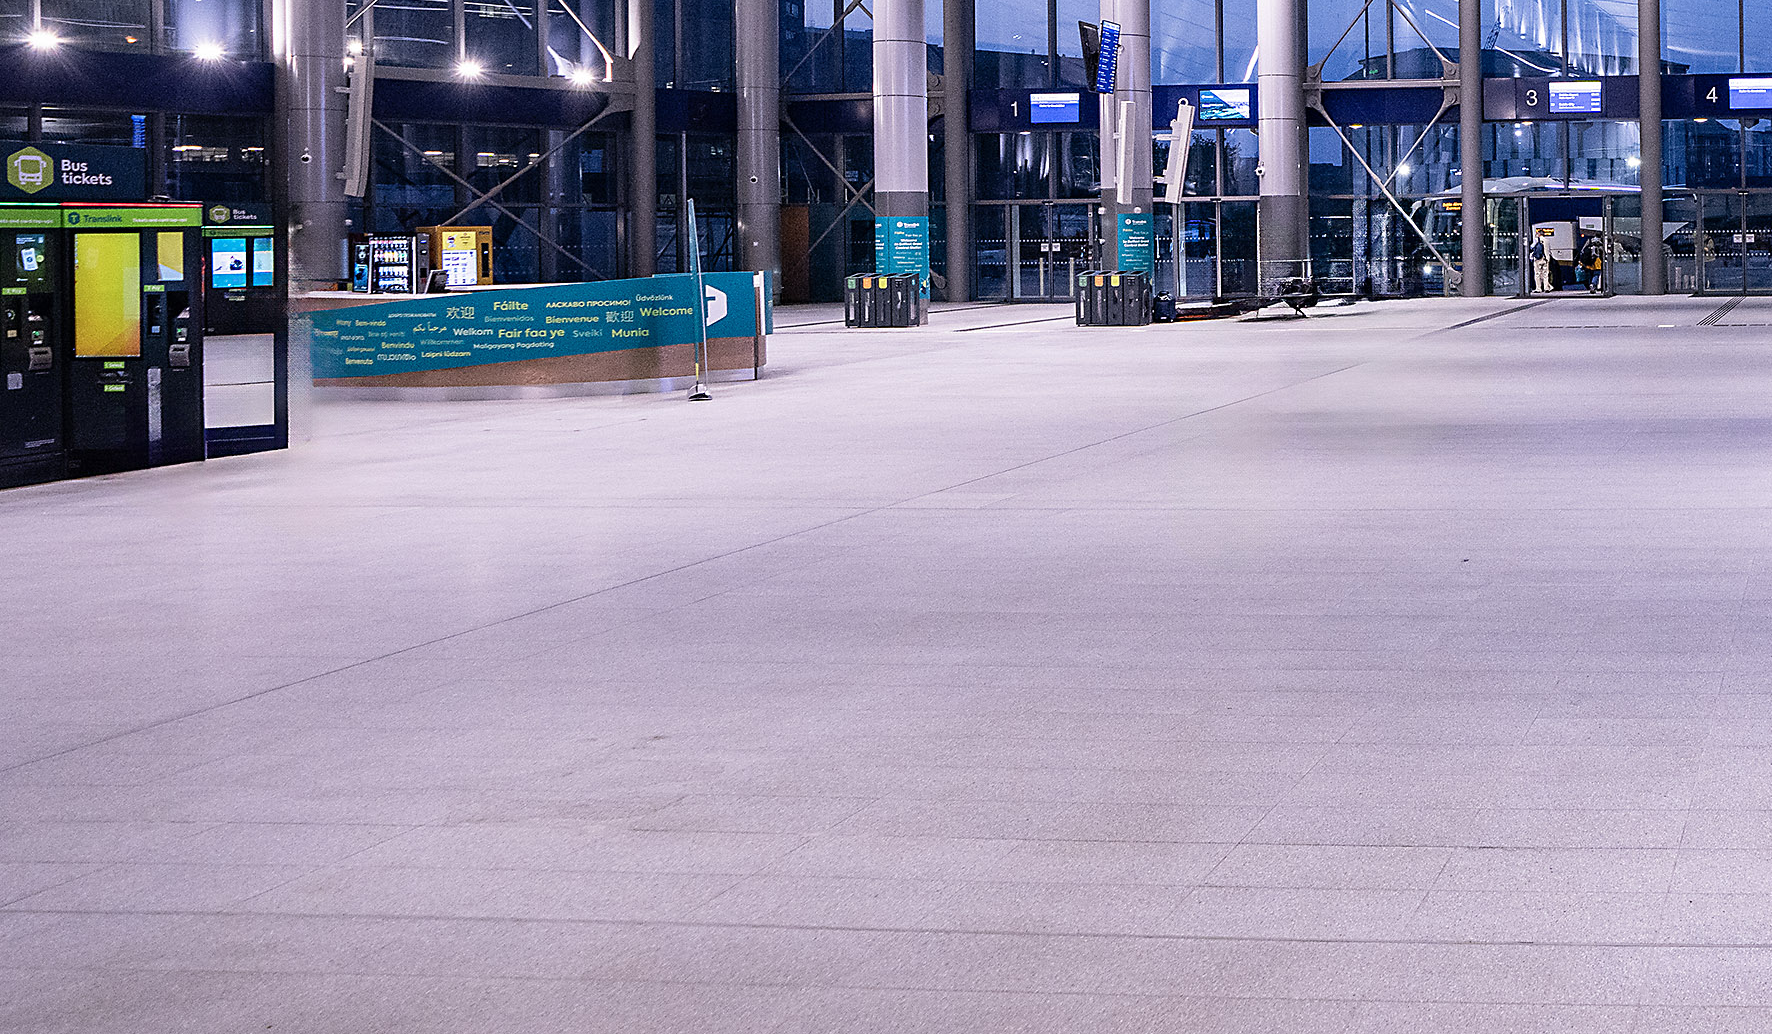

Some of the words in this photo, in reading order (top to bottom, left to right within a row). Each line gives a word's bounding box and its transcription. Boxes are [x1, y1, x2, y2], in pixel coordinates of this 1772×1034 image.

[1526, 89, 1538, 106] 3
[1705, 87, 1718, 103] 4
[1010, 101, 1018, 117] 1
[61, 159, 88, 172] Bus
[61, 172, 113, 186] tickets
[83, 214, 122, 224] Translink
[587, 299, 631, 307] ПРОСИМО!
[636, 294, 673, 302] Üdvözlünk
[493, 301, 529, 311] Fáilte
[446, 306, 475, 320] 欢迎
[605, 310, 634, 323] 歡迎
[639, 307, 693, 317] Welcome
[484, 315, 534, 323] Bienvenidos
[546, 316, 599, 324] Bienvenue
[453, 327, 493, 336] Welkom
[498, 328, 523, 338] Fair
[525, 328, 547, 338] faa
[549, 329, 565, 339] ye
[572, 328, 603, 337] Sveiki
[611, 328, 650, 338] Munia
[516, 341, 555, 349] Pagdating
